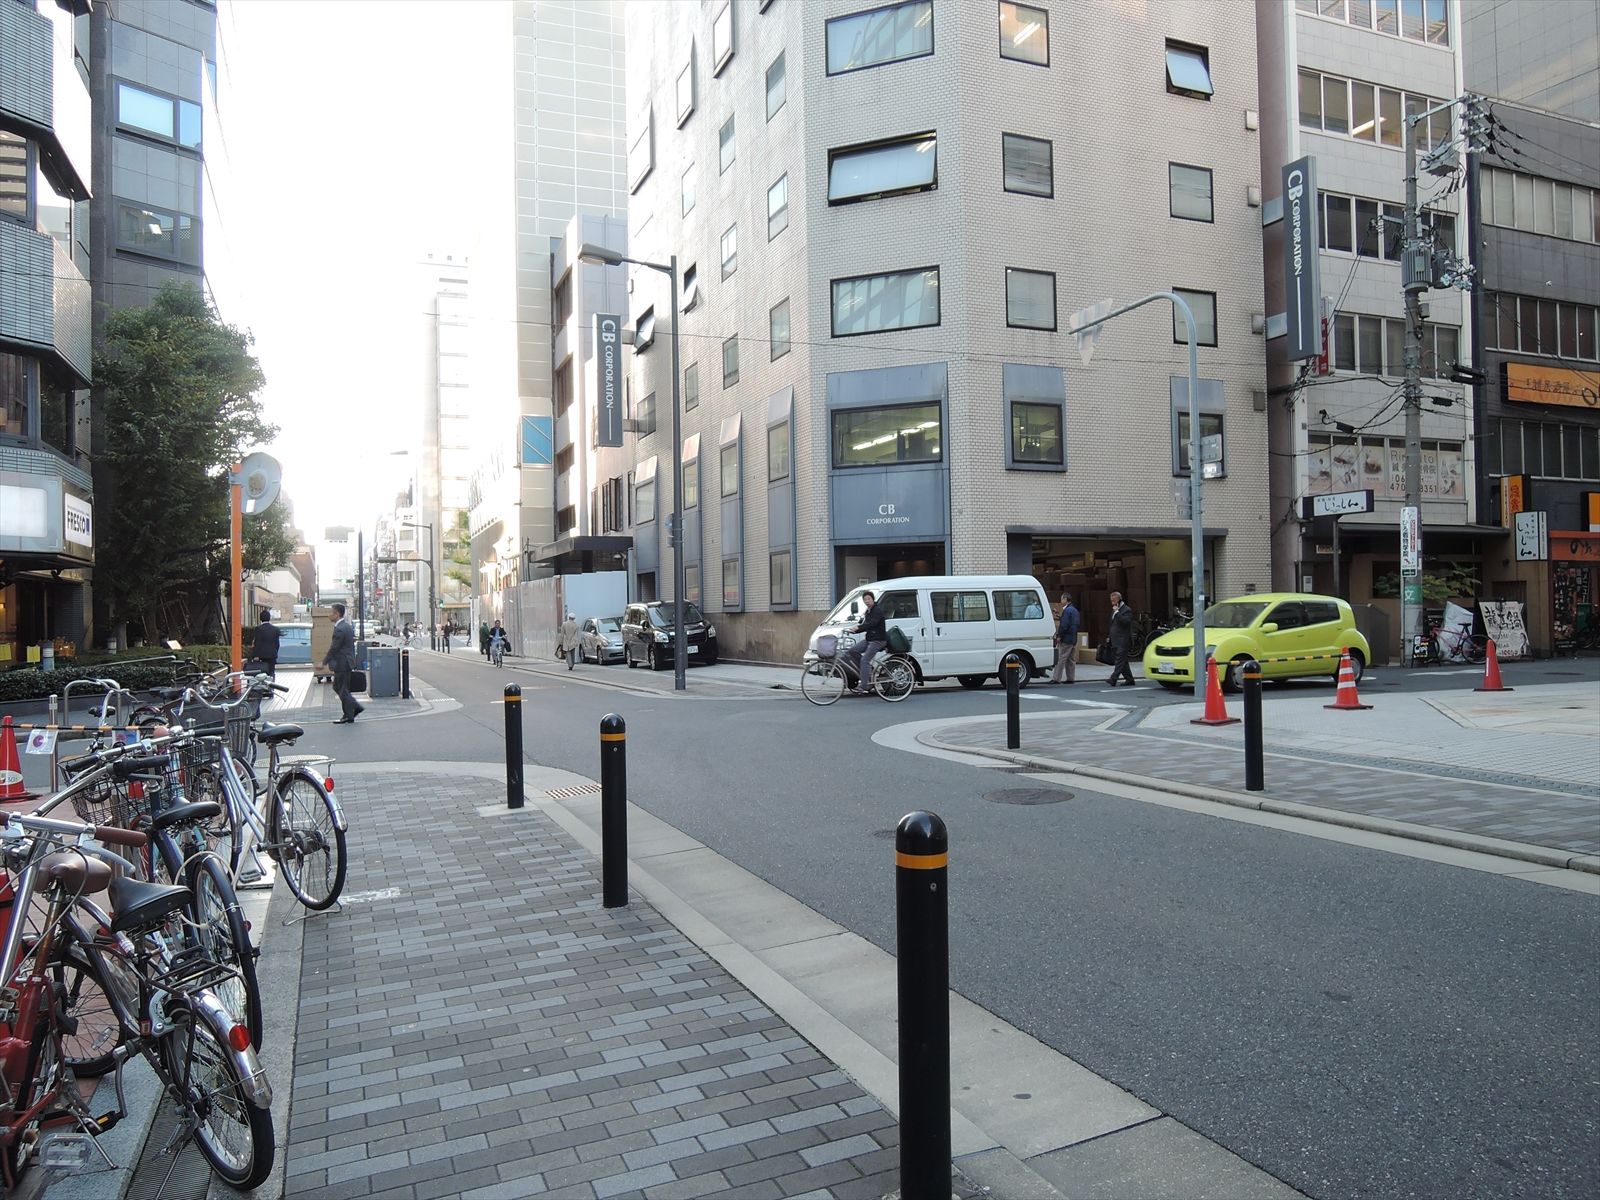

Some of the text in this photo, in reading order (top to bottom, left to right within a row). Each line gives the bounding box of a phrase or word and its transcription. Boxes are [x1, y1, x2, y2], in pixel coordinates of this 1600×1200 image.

[1288, 170, 1303, 276] CB CORPORATION
[602, 320, 616, 408] CB CORPORATION
[867, 517, 909, 525] CORPORATION
[879, 504, 895, 515] CB
[67, 510, 86, 534] FRESCO
